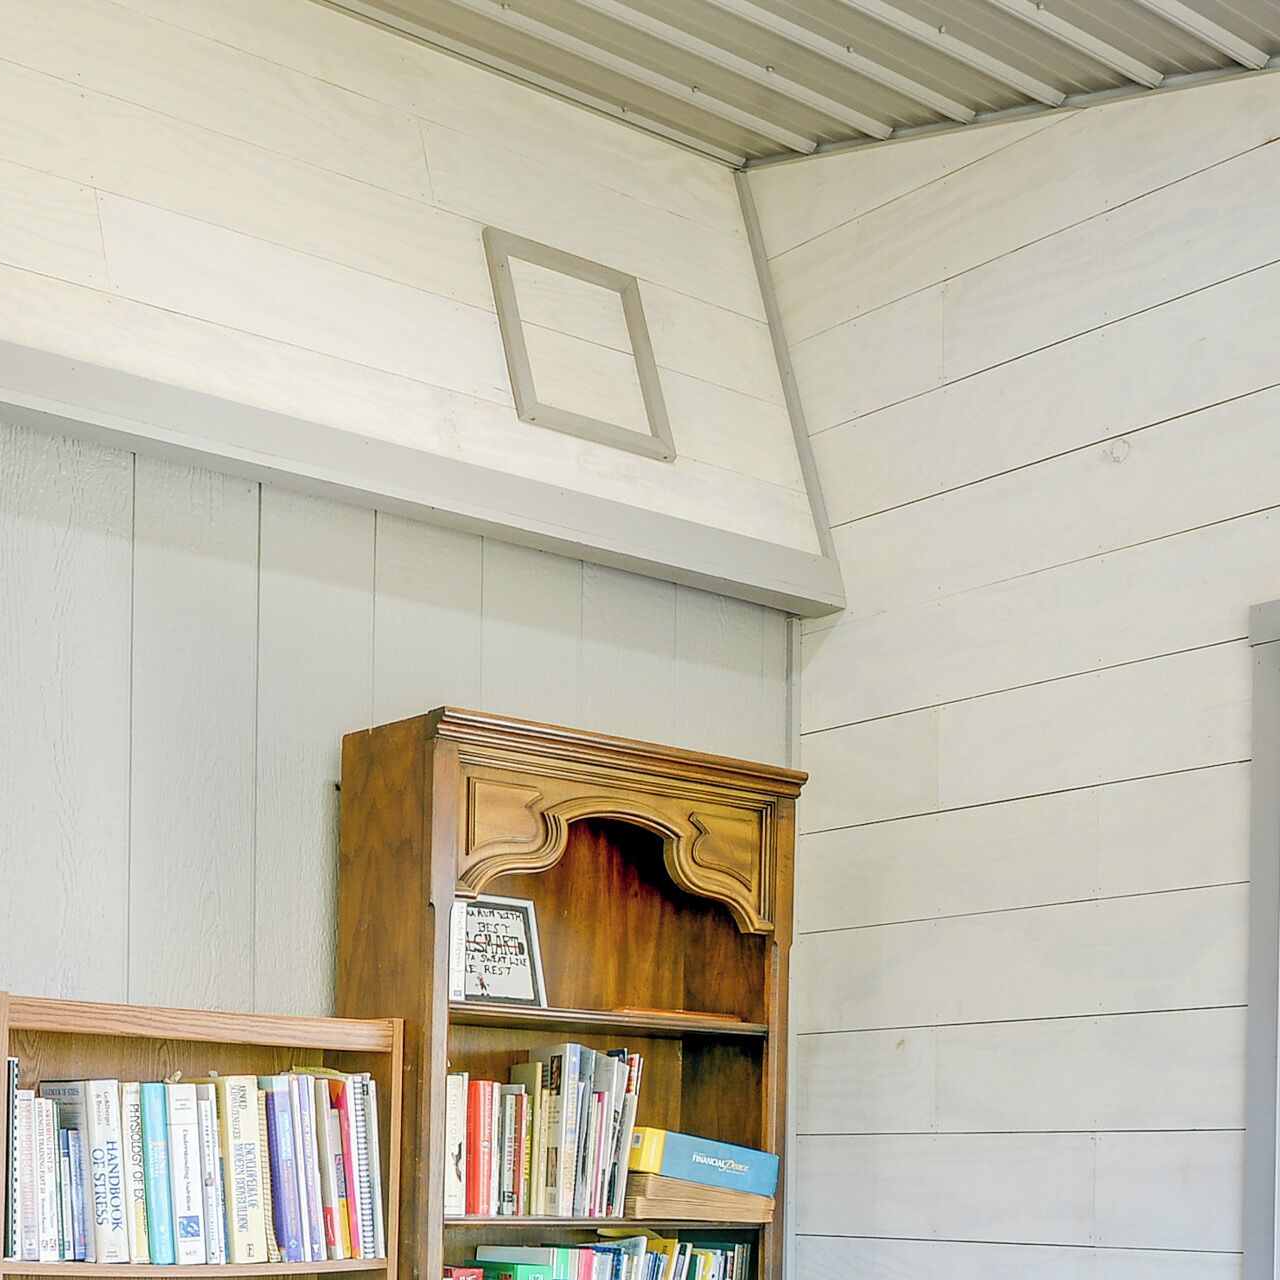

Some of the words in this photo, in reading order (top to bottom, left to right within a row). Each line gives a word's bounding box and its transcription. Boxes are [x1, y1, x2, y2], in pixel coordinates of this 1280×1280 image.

[477, 922, 510, 934] BEST
[480, 955, 508, 963] SWEAT
[484, 964, 511, 975] REST
[239, 1085, 247, 1110] ARNOLD
[130, 1104, 142, 1167] PHYSIOLOGY
[91, 1148, 104, 1166] OF
[182, 1129, 192, 1180] Understanding
[233, 1143, 244, 1175] MODERN
[245, 1142, 257, 1197] ENCYCLOPEDIA
[106, 1141, 123, 1232] HANDBOOK
[133, 1172, 143, 1185] OF
[94, 1173, 108, 1226] STRESS
[184, 1182, 192, 1212] Nutrition
[235, 1177, 248, 1233] BODYBUILDING
[248, 1199, 259, 1209] OF
